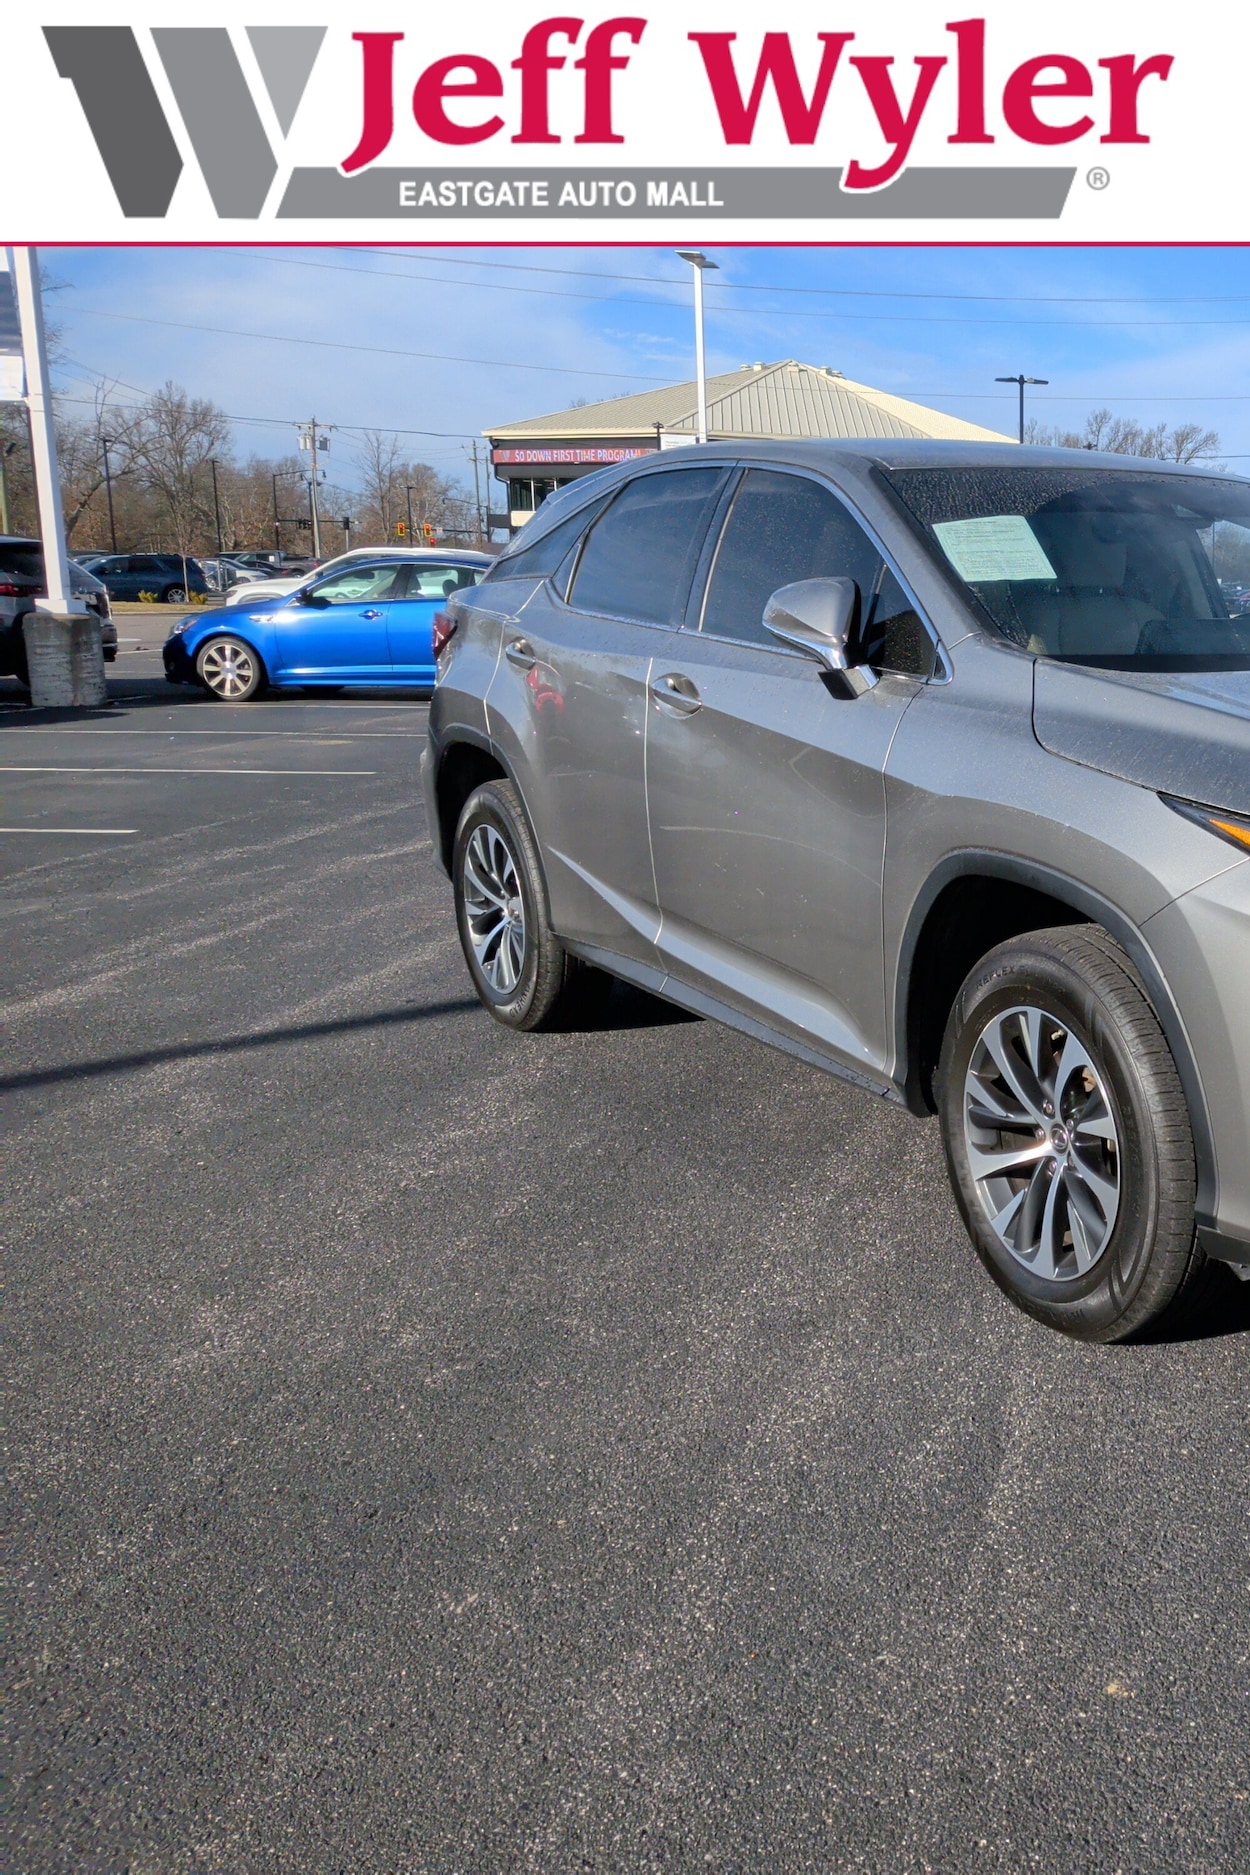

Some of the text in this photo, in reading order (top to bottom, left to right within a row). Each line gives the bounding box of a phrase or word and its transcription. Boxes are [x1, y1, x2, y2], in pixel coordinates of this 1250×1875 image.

[526, 450, 552, 462] DOWN
[553, 450, 575, 461] FIRST
[575, 449, 596, 461] TIME
